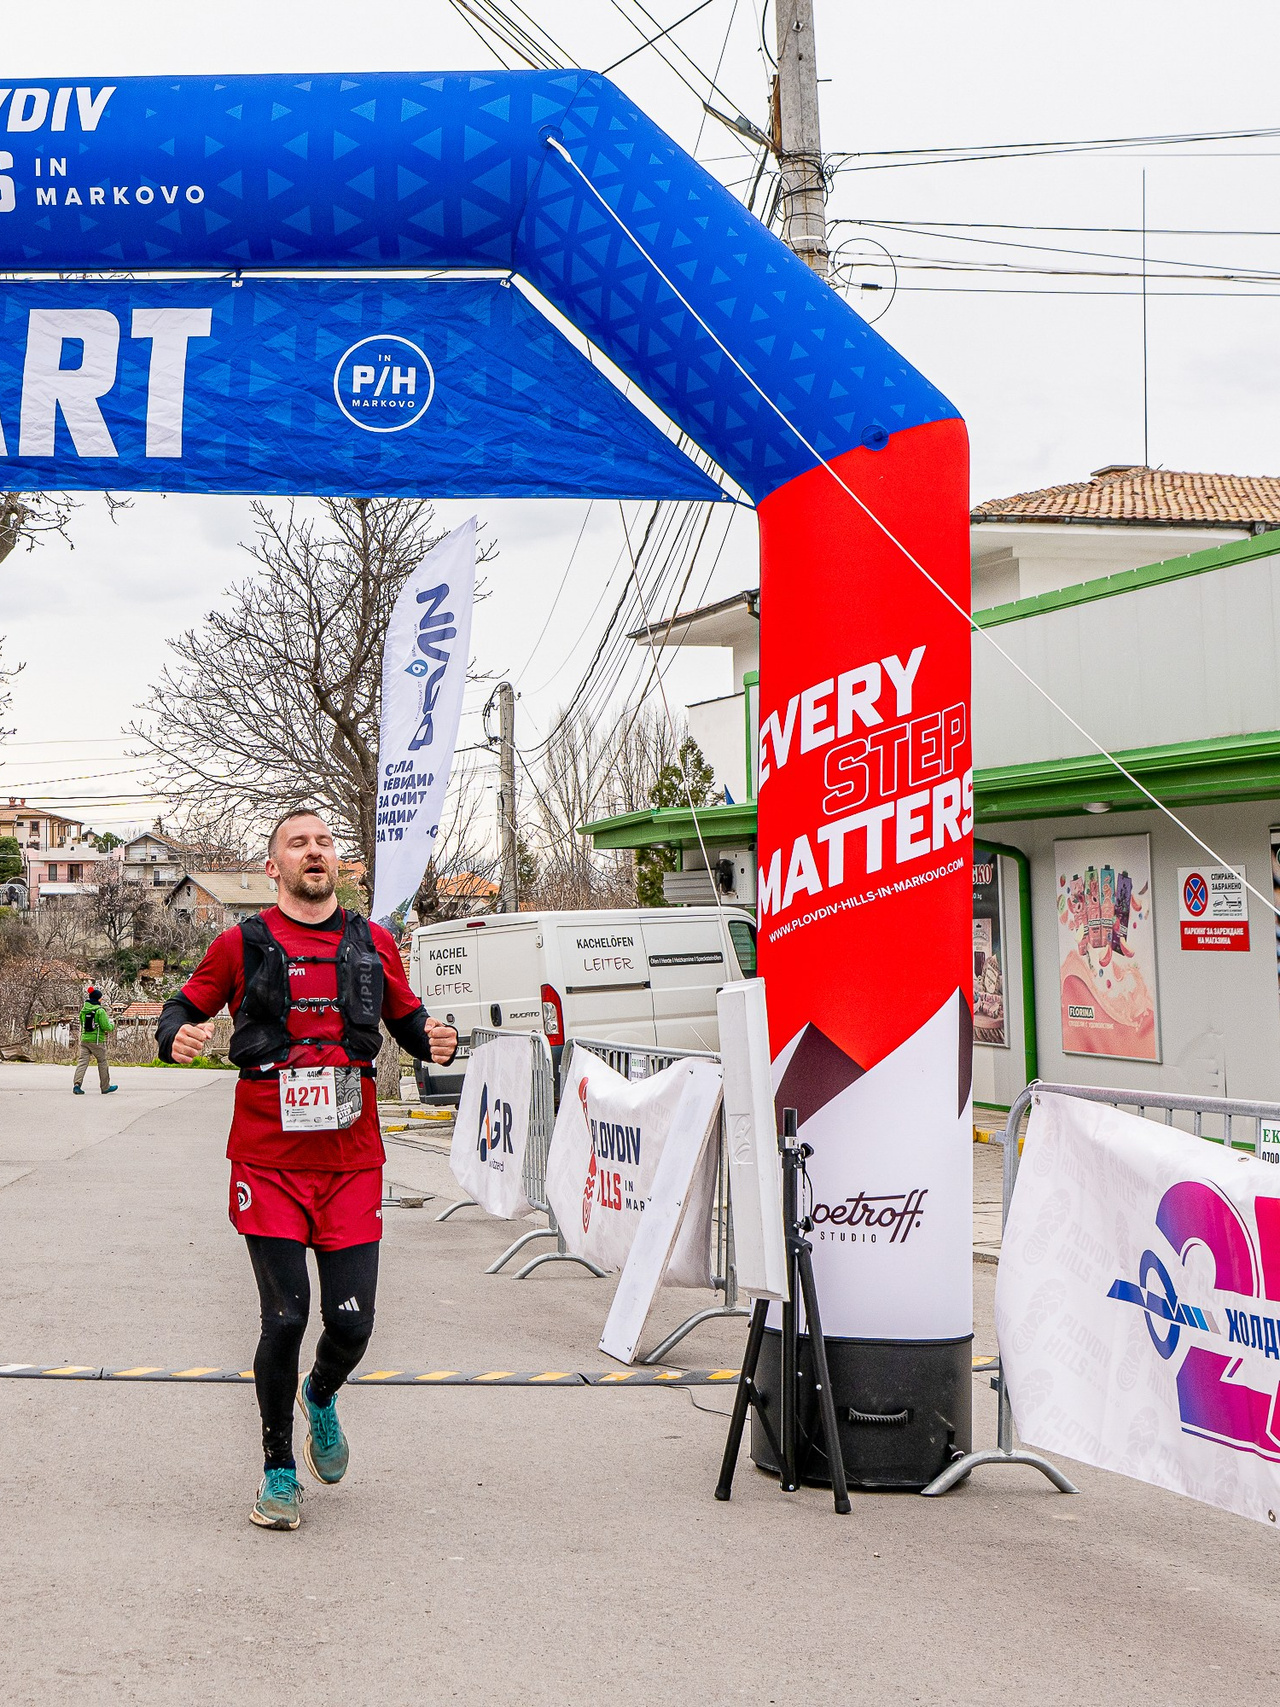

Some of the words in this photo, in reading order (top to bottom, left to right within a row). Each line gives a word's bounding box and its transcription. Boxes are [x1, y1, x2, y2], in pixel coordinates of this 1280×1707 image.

[35, 158, 67, 177] IN
[35, 185, 205, 206] MARKOVO
[378, 354, 391, 362] IN
[352, 365, 416, 397] P/H
[351, 399, 415, 408] MARKOVO
[758, 645, 927, 793] EVERY
[822, 701, 967, 816] STEP
[383, 773, 435, 791] ЕВИДИ
[387, 827, 408, 842] ТЯ
[758, 765, 974, 933] MATTERS
[1210, 873, 1242, 881] СПИРАНЕ
[1211, 883, 1242, 891] ЗАБРАНЕНО
[768, 856, 965, 944] WWW.PLOVDIV-HILLS-IN-MARKOVO.COM
[576, 934, 634, 949] KACHELÖFEN
[429, 946, 468, 961] KACHEL
[436, 962, 462, 976] ÖFEN
[583, 956, 635, 972] LEITER
[360, 952, 375, 1017] KIPRUN
[426, 981, 473, 997] LEITER
[509, 1010, 540, 1019] DUCATO
[1069, 1006, 1095, 1018] FLORINA
[285, 1085, 330, 1107] 4271
[625, 1179, 634, 1192] IN
[820, 1231, 877, 1243] STUDIO
